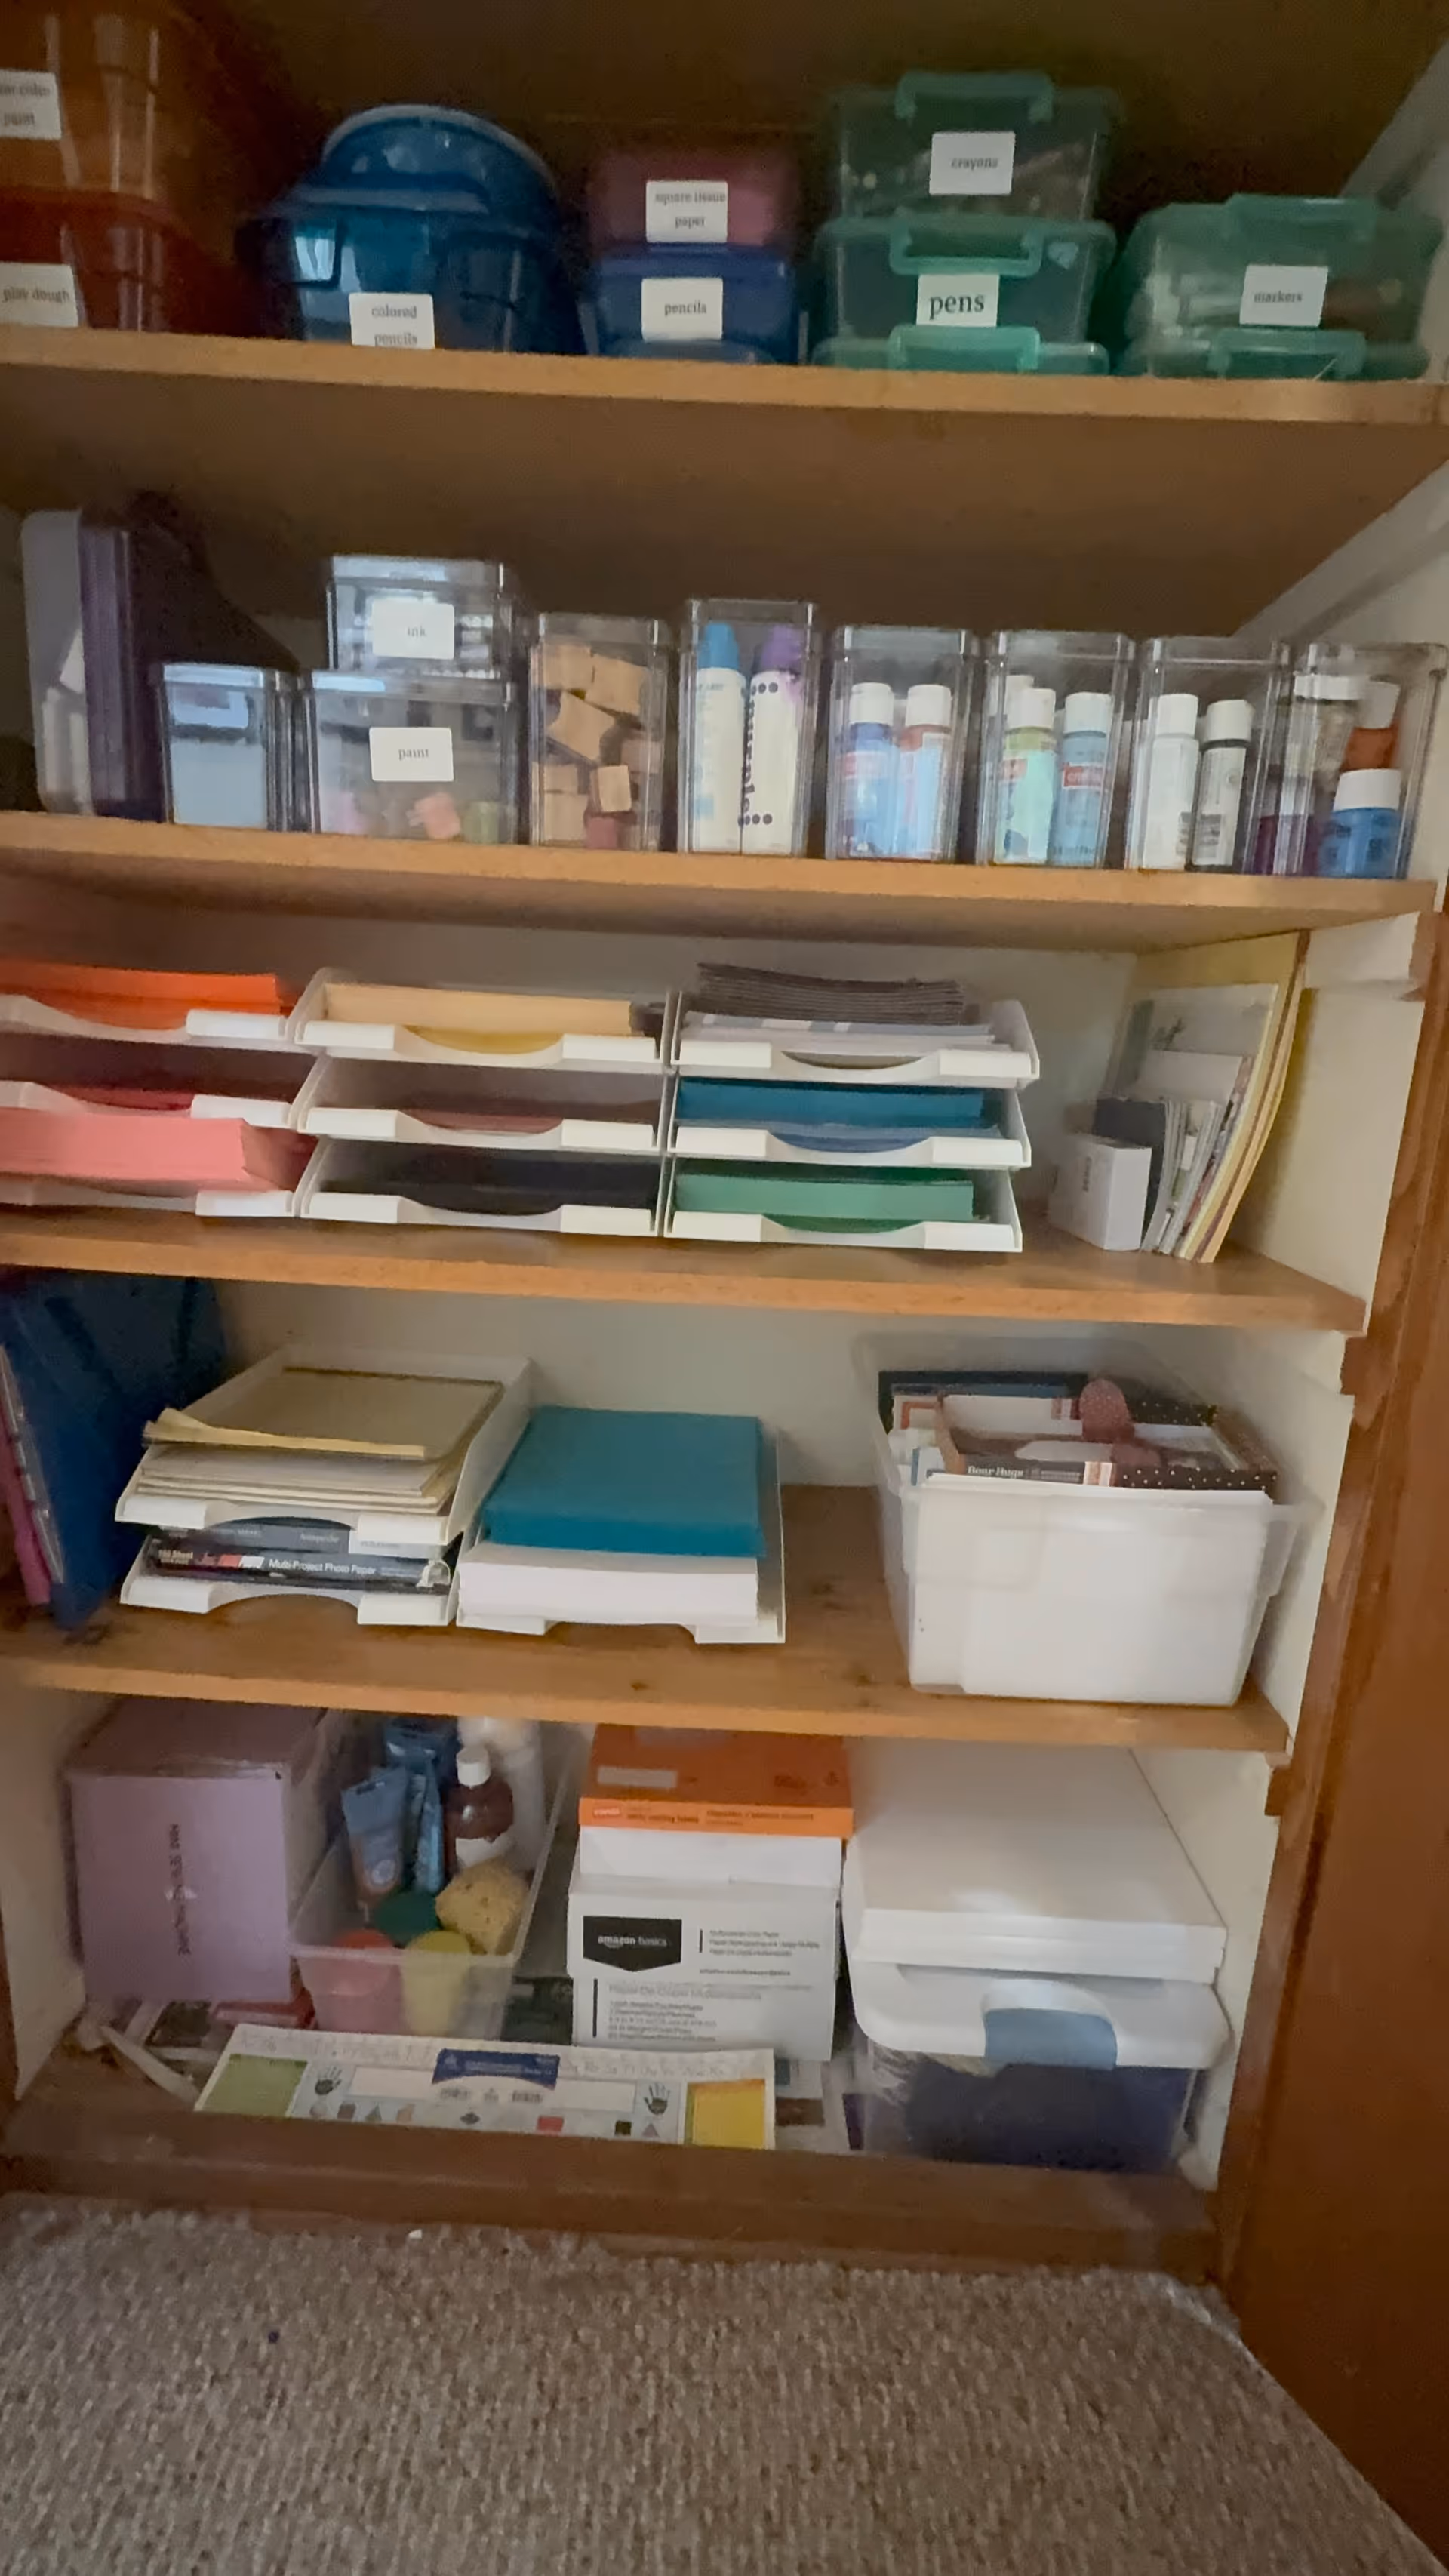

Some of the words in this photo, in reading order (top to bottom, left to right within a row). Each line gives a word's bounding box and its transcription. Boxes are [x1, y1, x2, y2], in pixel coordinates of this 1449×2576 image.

[950, 157, 999, 172] crayons
[694, 190, 726, 203] tissue
[675, 216, 706, 230] paper
[32, 286, 69, 304] dough
[1254, 290, 1303, 303] markers
[371, 303, 417, 319] colored
[664, 299, 707, 317] pencils
[929, 294, 985, 322] pens
[374, 331, 418, 347] pencils
[407, 624, 428, 638] ink
[398, 748, 429, 762] paint
[967, 1465, 995, 1476] Bear
[324, 1562, 351, 1574] Photo
[350, 1564, 377, 1575] Paper
[597, 1935, 636, 1947] amazon
[638, 1936, 668, 1947] basics
